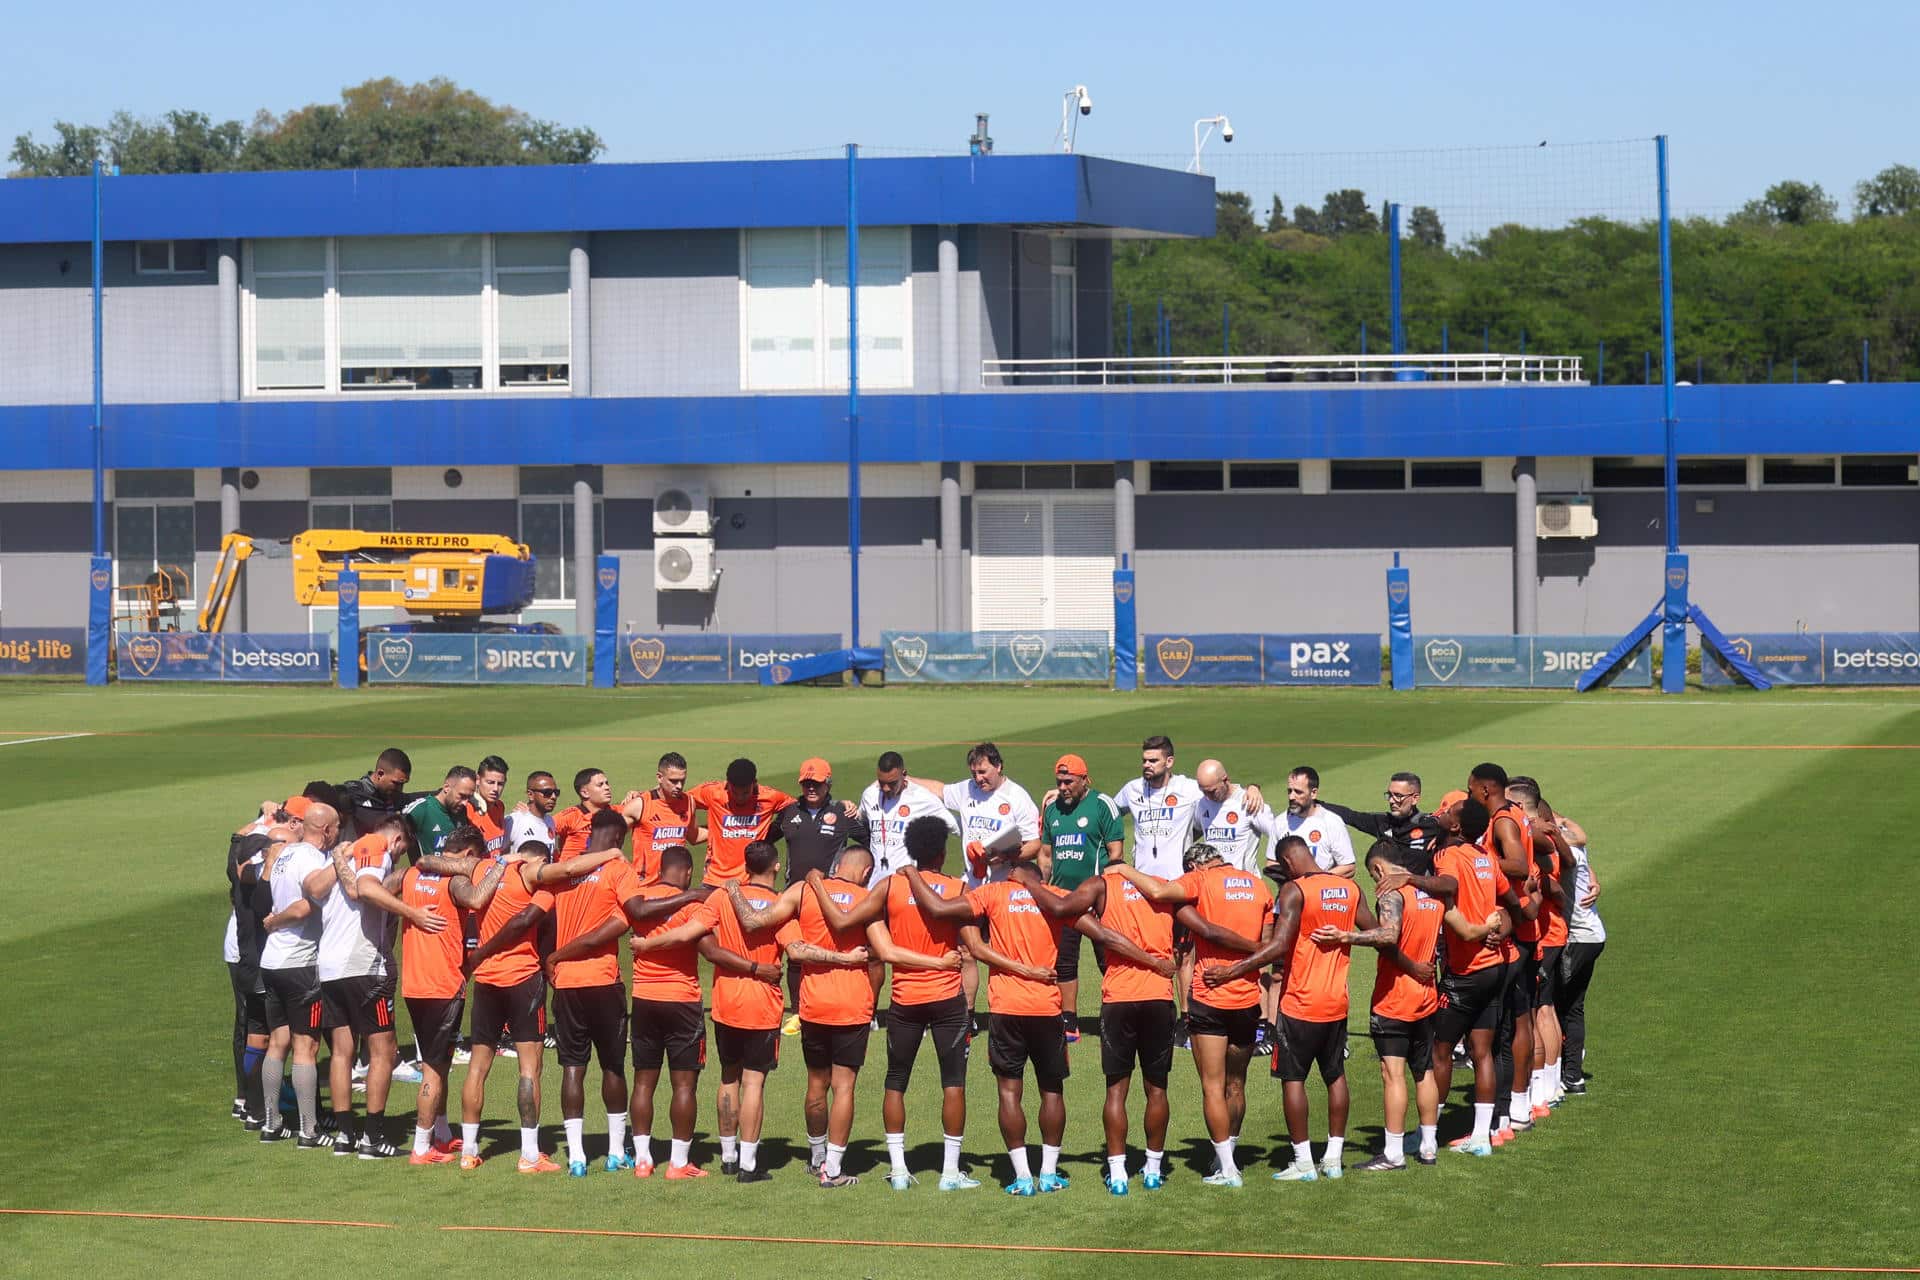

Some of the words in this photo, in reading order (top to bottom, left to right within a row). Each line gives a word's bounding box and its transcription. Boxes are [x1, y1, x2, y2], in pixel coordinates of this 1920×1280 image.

[380, 535, 413, 545] HA16
[416, 536, 439, 546] RTJ
[443, 536, 469, 547] PRO
[232, 647, 319, 667] betsson
[486, 648, 576, 669] DIRECTV
[1162, 651, 1188, 660] CABJ
[1291, 641, 1350, 668] pax
[1431, 648, 1456, 656] BOCA
[1834, 648, 1920, 668] betsso
[1291, 668, 1350, 677] assistance
